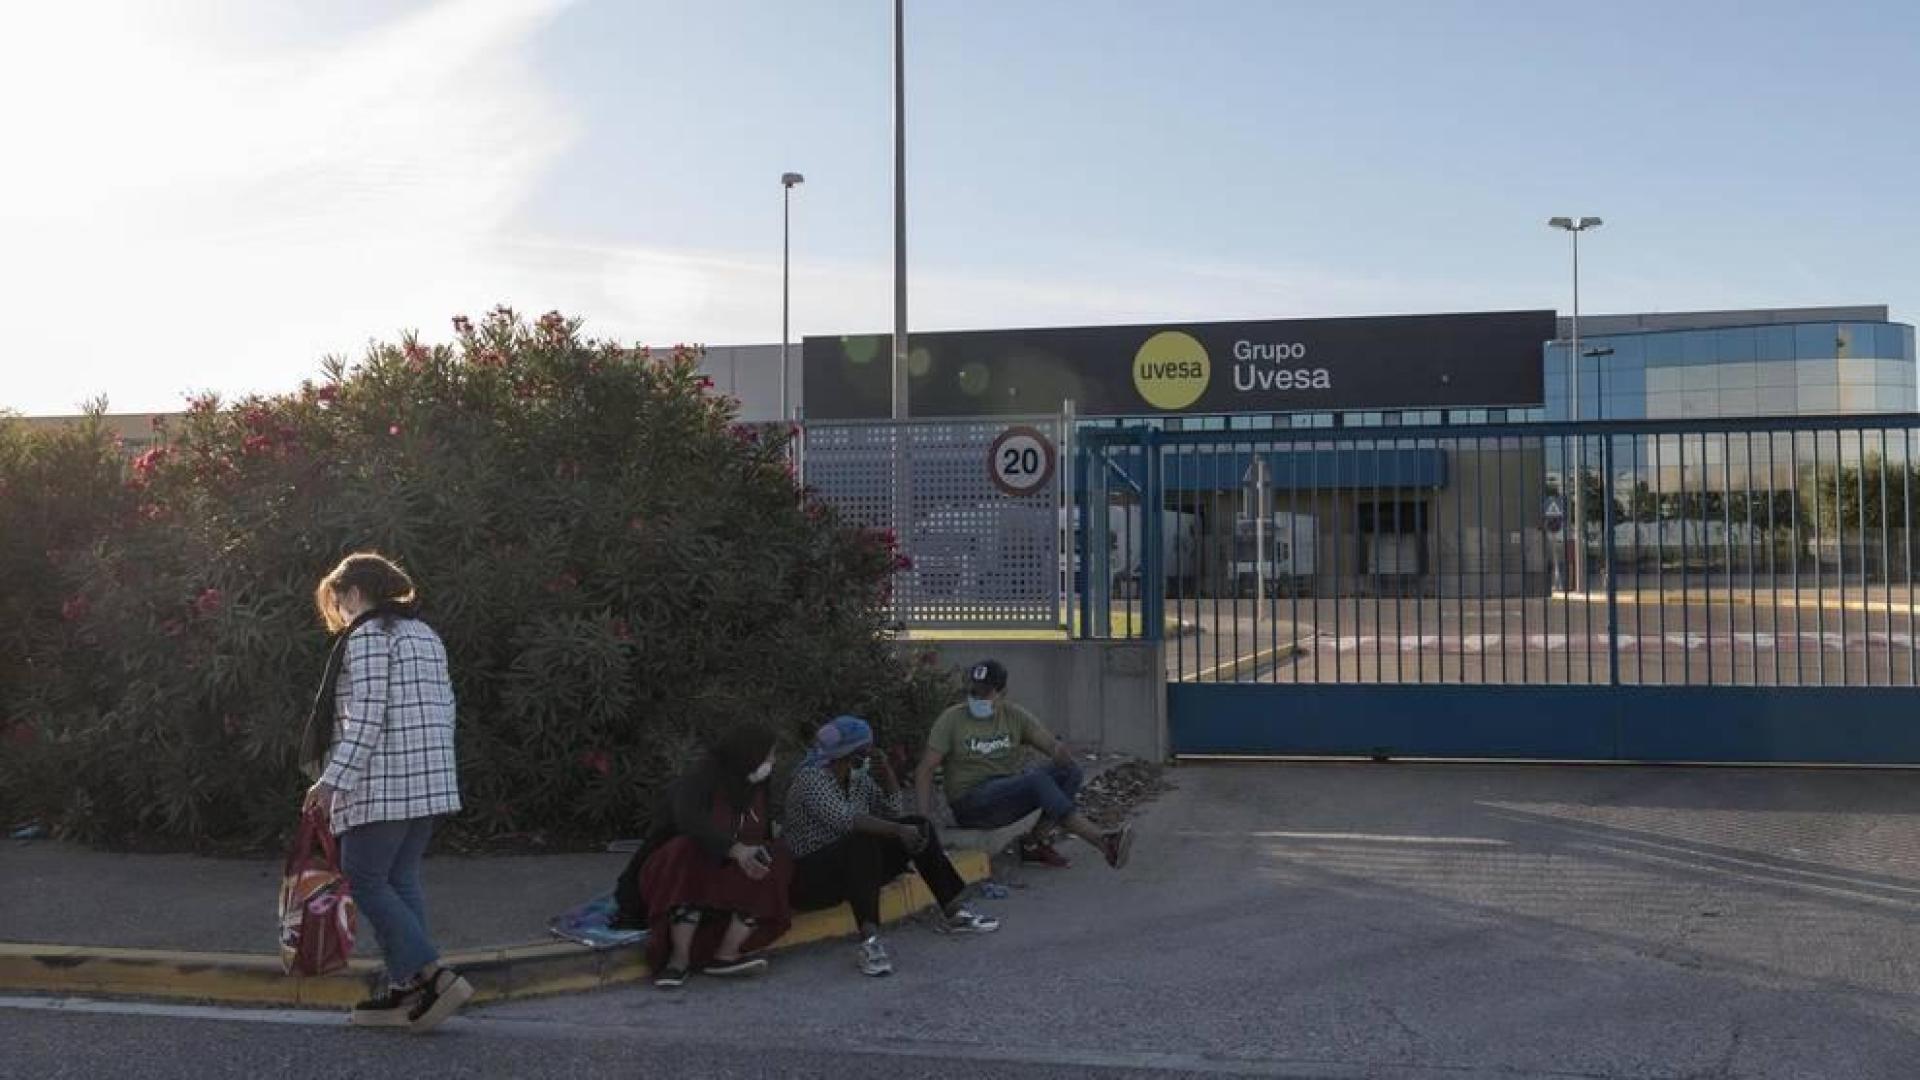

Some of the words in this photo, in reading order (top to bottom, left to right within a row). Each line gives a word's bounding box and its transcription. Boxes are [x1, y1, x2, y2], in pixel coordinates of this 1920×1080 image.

[1233, 340, 1306, 362] Grupo
[1141, 361, 1203, 380] uvesa
[1233, 364, 1332, 391] Uvesa
[1004, 448, 1039, 474] 20
